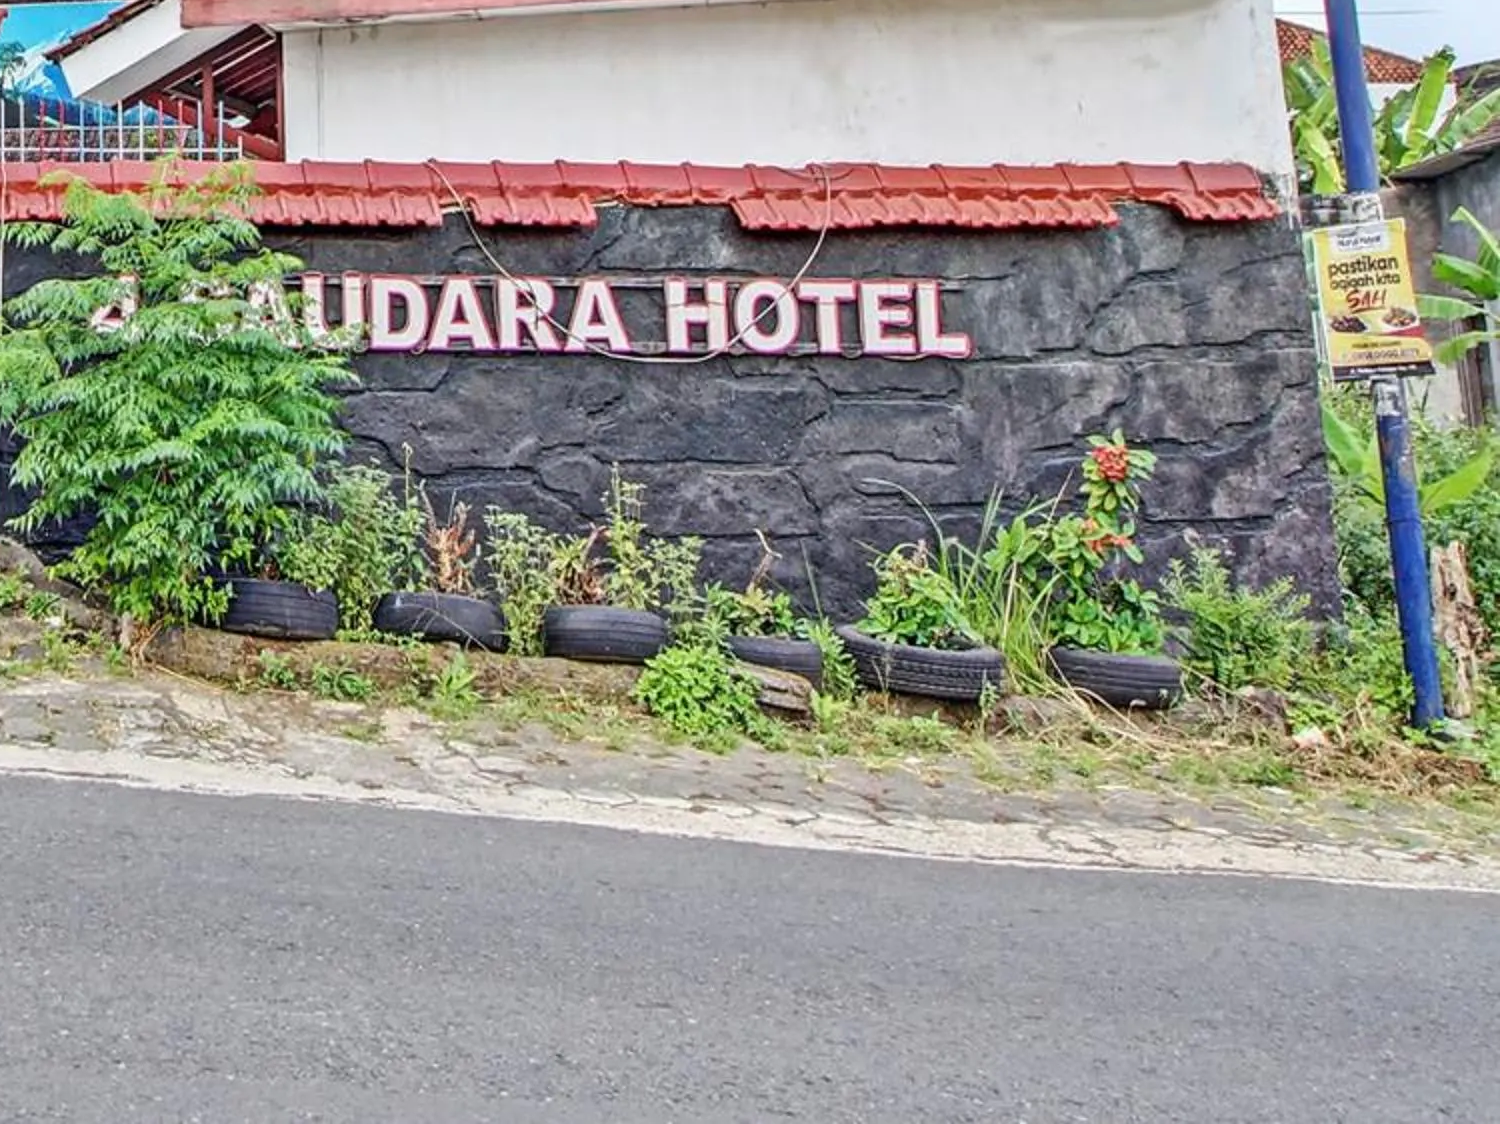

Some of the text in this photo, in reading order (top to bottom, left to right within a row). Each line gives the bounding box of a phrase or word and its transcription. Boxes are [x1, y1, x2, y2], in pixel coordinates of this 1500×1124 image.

[1327, 256, 1399, 279] pastikan
[178, 272, 630, 354] AUDARA
[665, 276, 973, 358] HOTEL
